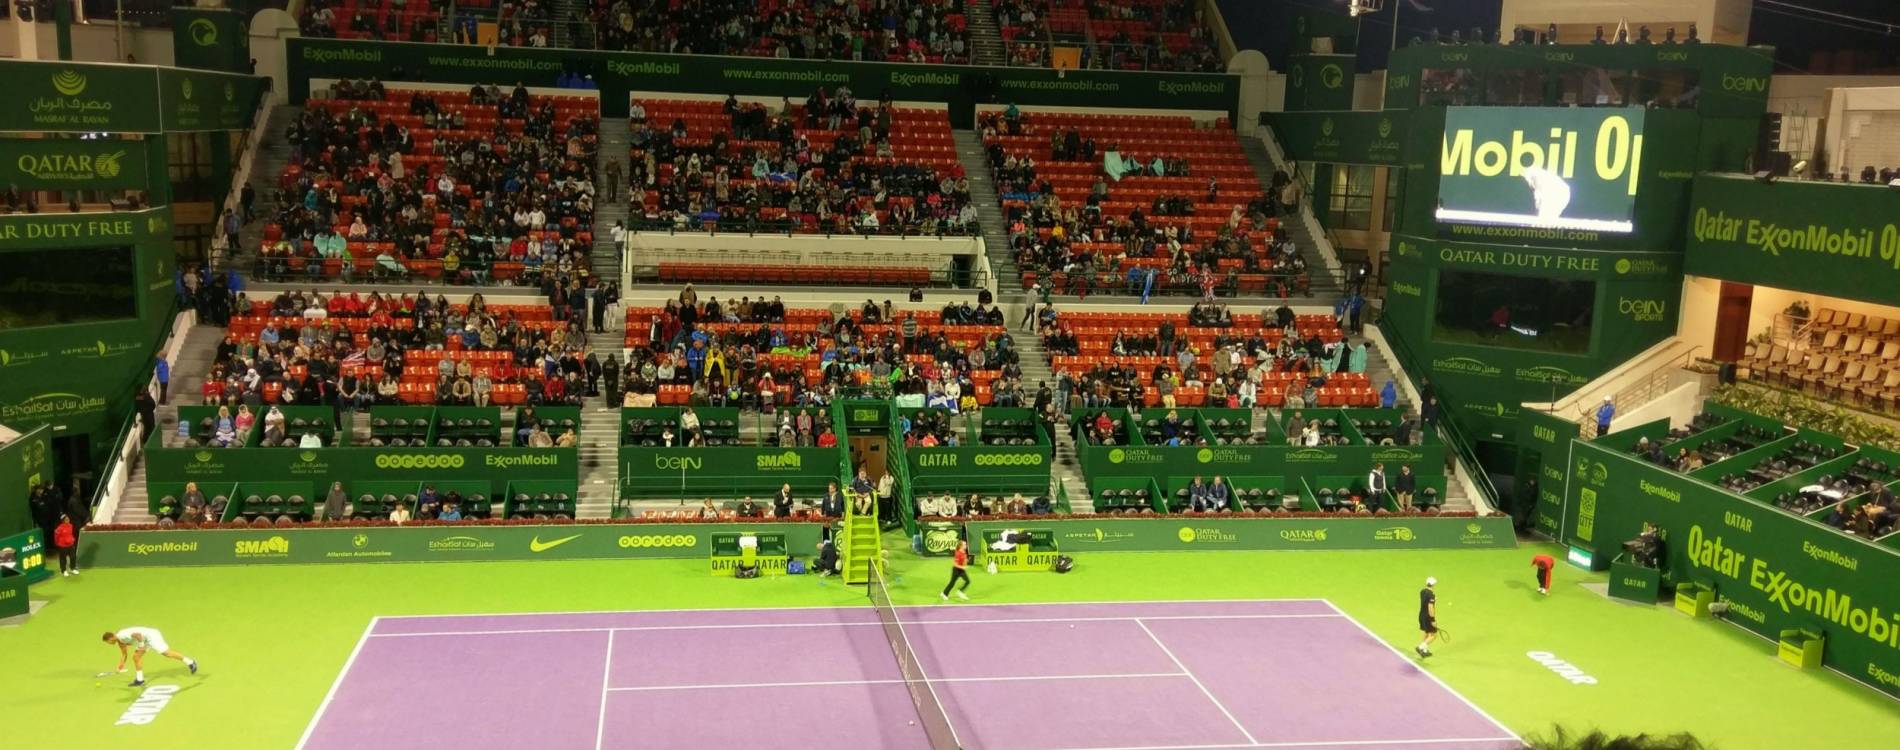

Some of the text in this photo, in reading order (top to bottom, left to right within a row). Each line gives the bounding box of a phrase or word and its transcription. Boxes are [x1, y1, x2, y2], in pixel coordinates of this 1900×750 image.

[303, 47, 381, 63] ExxonMobil
[428, 54, 563, 71] www.exxonmobil.com
[607, 60, 680, 77] ExxonMobil
[723, 68, 849, 83] www.exxonmobil.com
[891, 71, 959, 88] ExxonMobil
[1000, 77, 1119, 93] www.exxonmobil.com
[1158, 80, 1225, 95] ExxonMobil
[1722, 73, 1766, 92] beIN
[18, 154, 94, 177] QATAR
[27, 223, 83, 239] DUTY
[89, 220, 133, 236] FREE
[1452, 223, 1599, 241] www.exxonmobil.com
[1695, 207, 1742, 242] Qatar
[1747, 219, 1873, 257] ExxonMobil
[1440, 248, 1496, 265] QATAR
[1502, 252, 1552, 269] DUTY
[1556, 256, 1600, 272] FREE
[1619, 296, 1665, 314] beIN
[1533, 425, 1556, 443] QATAR
[376, 454, 464, 468] ooredoo
[486, 454, 557, 468] ExxonMobil
[656, 453, 702, 469] beIN
[919, 454, 957, 467] QATAR
[975, 454, 1042, 466] ooredoo
[1640, 479, 1681, 503] ExxonMobil
[1724, 511, 1752, 533] QATAR
[22, 541, 41, 552] ROLEX
[128, 542, 197, 555] ExxonMobil
[619, 535, 696, 548] ooredoo
[1027, 555, 1058, 565] QATAR
[1803, 541, 1858, 571] ExxonMobil
[1624, 577, 1647, 588] QATAR
[1688, 524, 1900, 650] Qatar ExxonMobi
[1526, 651, 1598, 684] QATAR
[113, 685, 180, 725] QATAR
